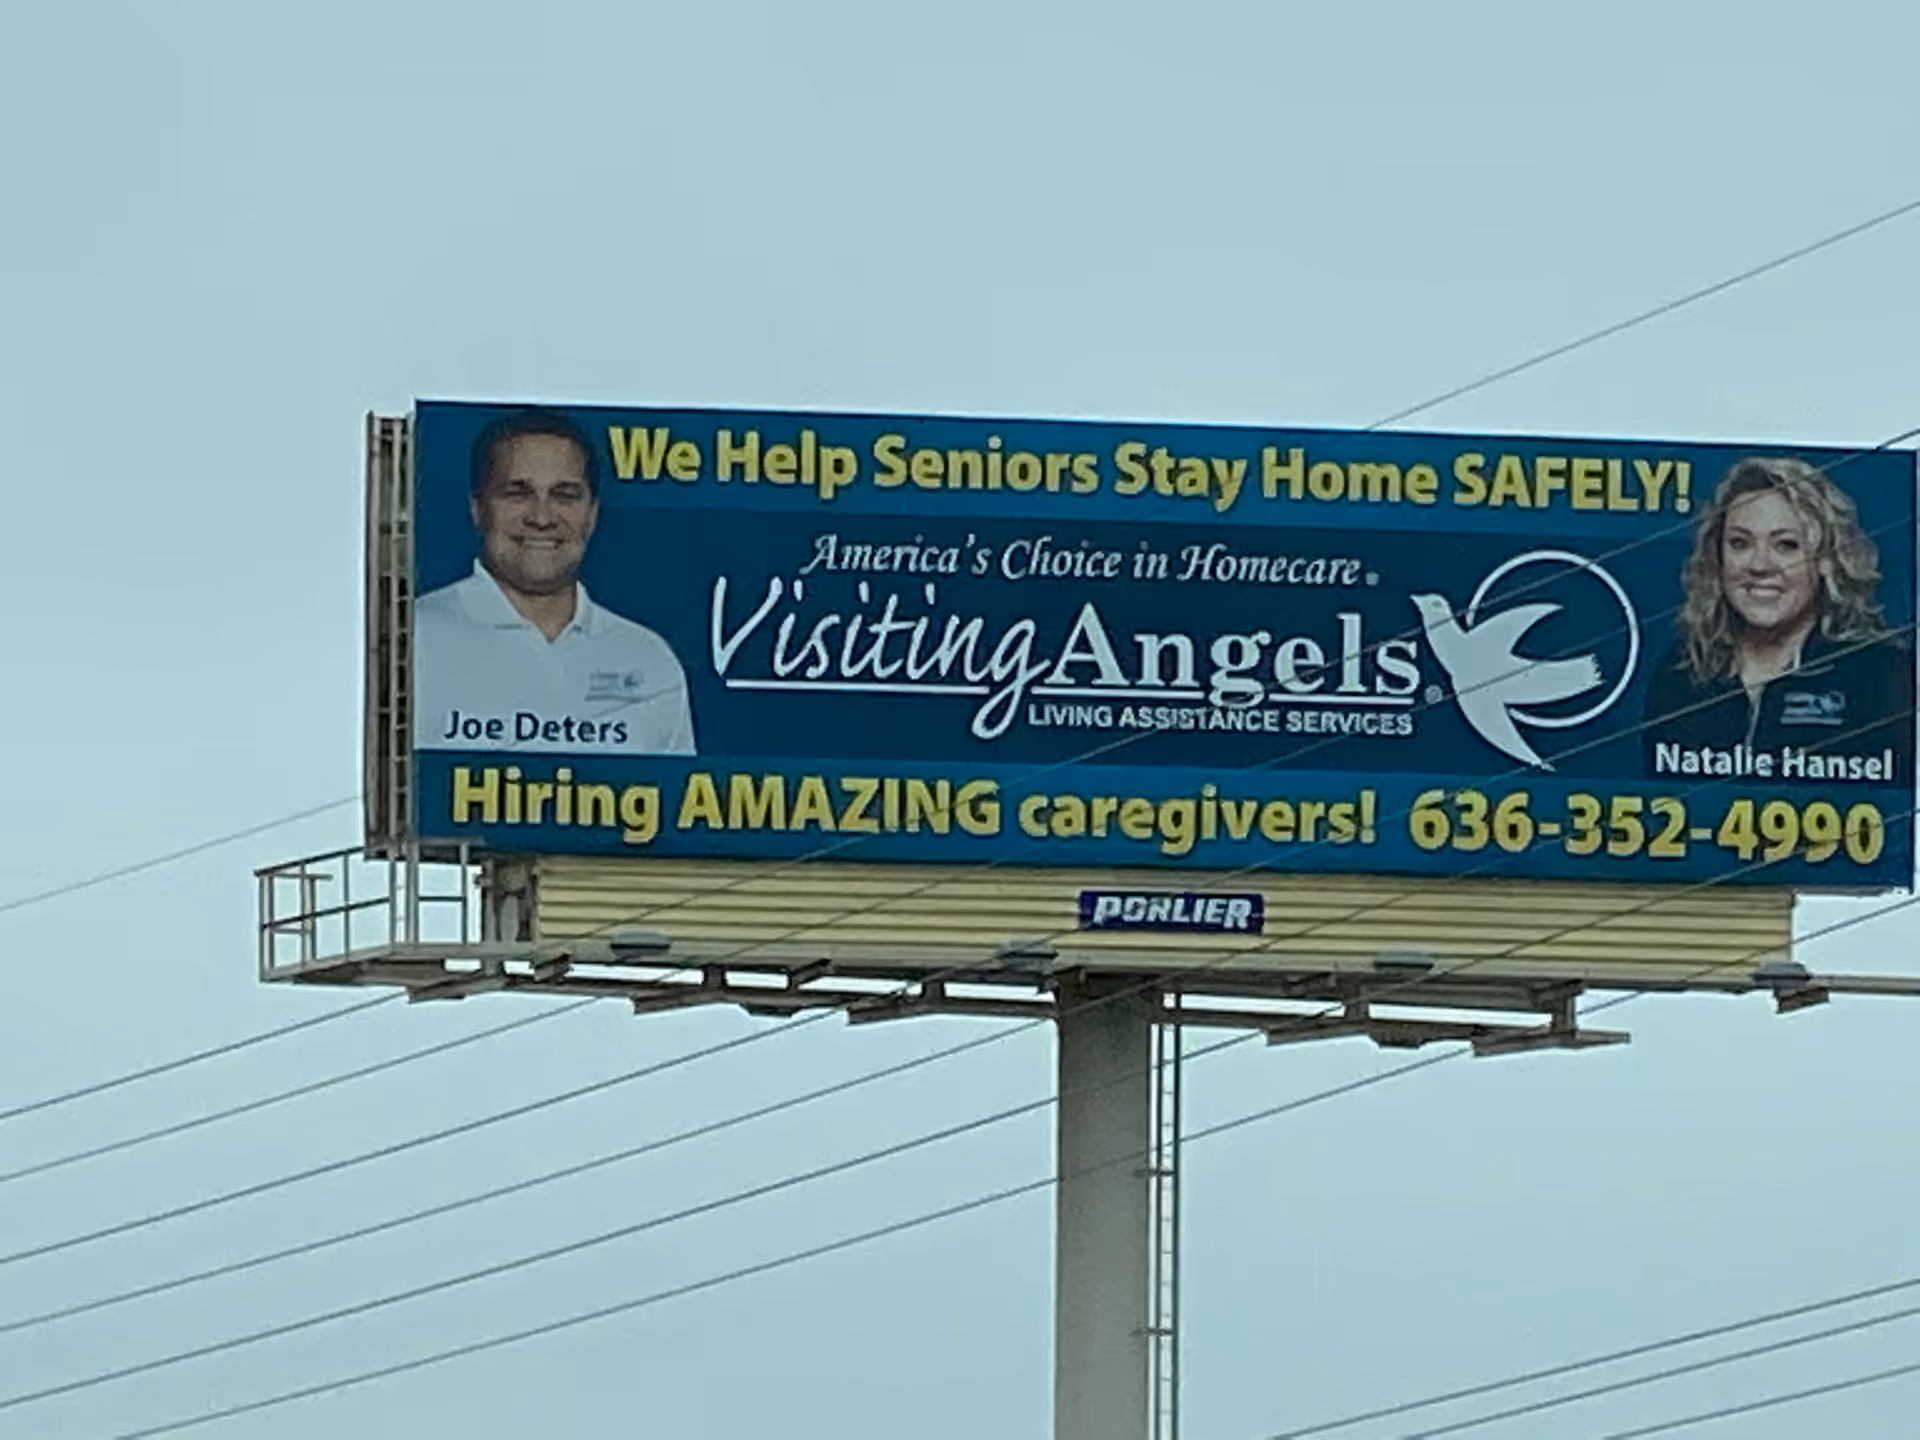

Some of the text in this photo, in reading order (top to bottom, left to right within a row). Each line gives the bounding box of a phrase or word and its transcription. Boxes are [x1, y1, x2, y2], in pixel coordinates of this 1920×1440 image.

[608, 426, 1692, 514] We Help Seniors Stay Home SAFELY!
[800, 533, 992, 576] America's
[1001, 536, 1122, 580] Choice
[1133, 541, 1168, 580] in
[444, 710, 628, 744] Joe Deters
[1028, 703, 1414, 736] LIVING ASSISTANCE SERVICES
[1655, 743, 1894, 782] Natalie Hansel
[453, 767, 1885, 865] Hiring AMAZING caregivers! 636-352-4990
